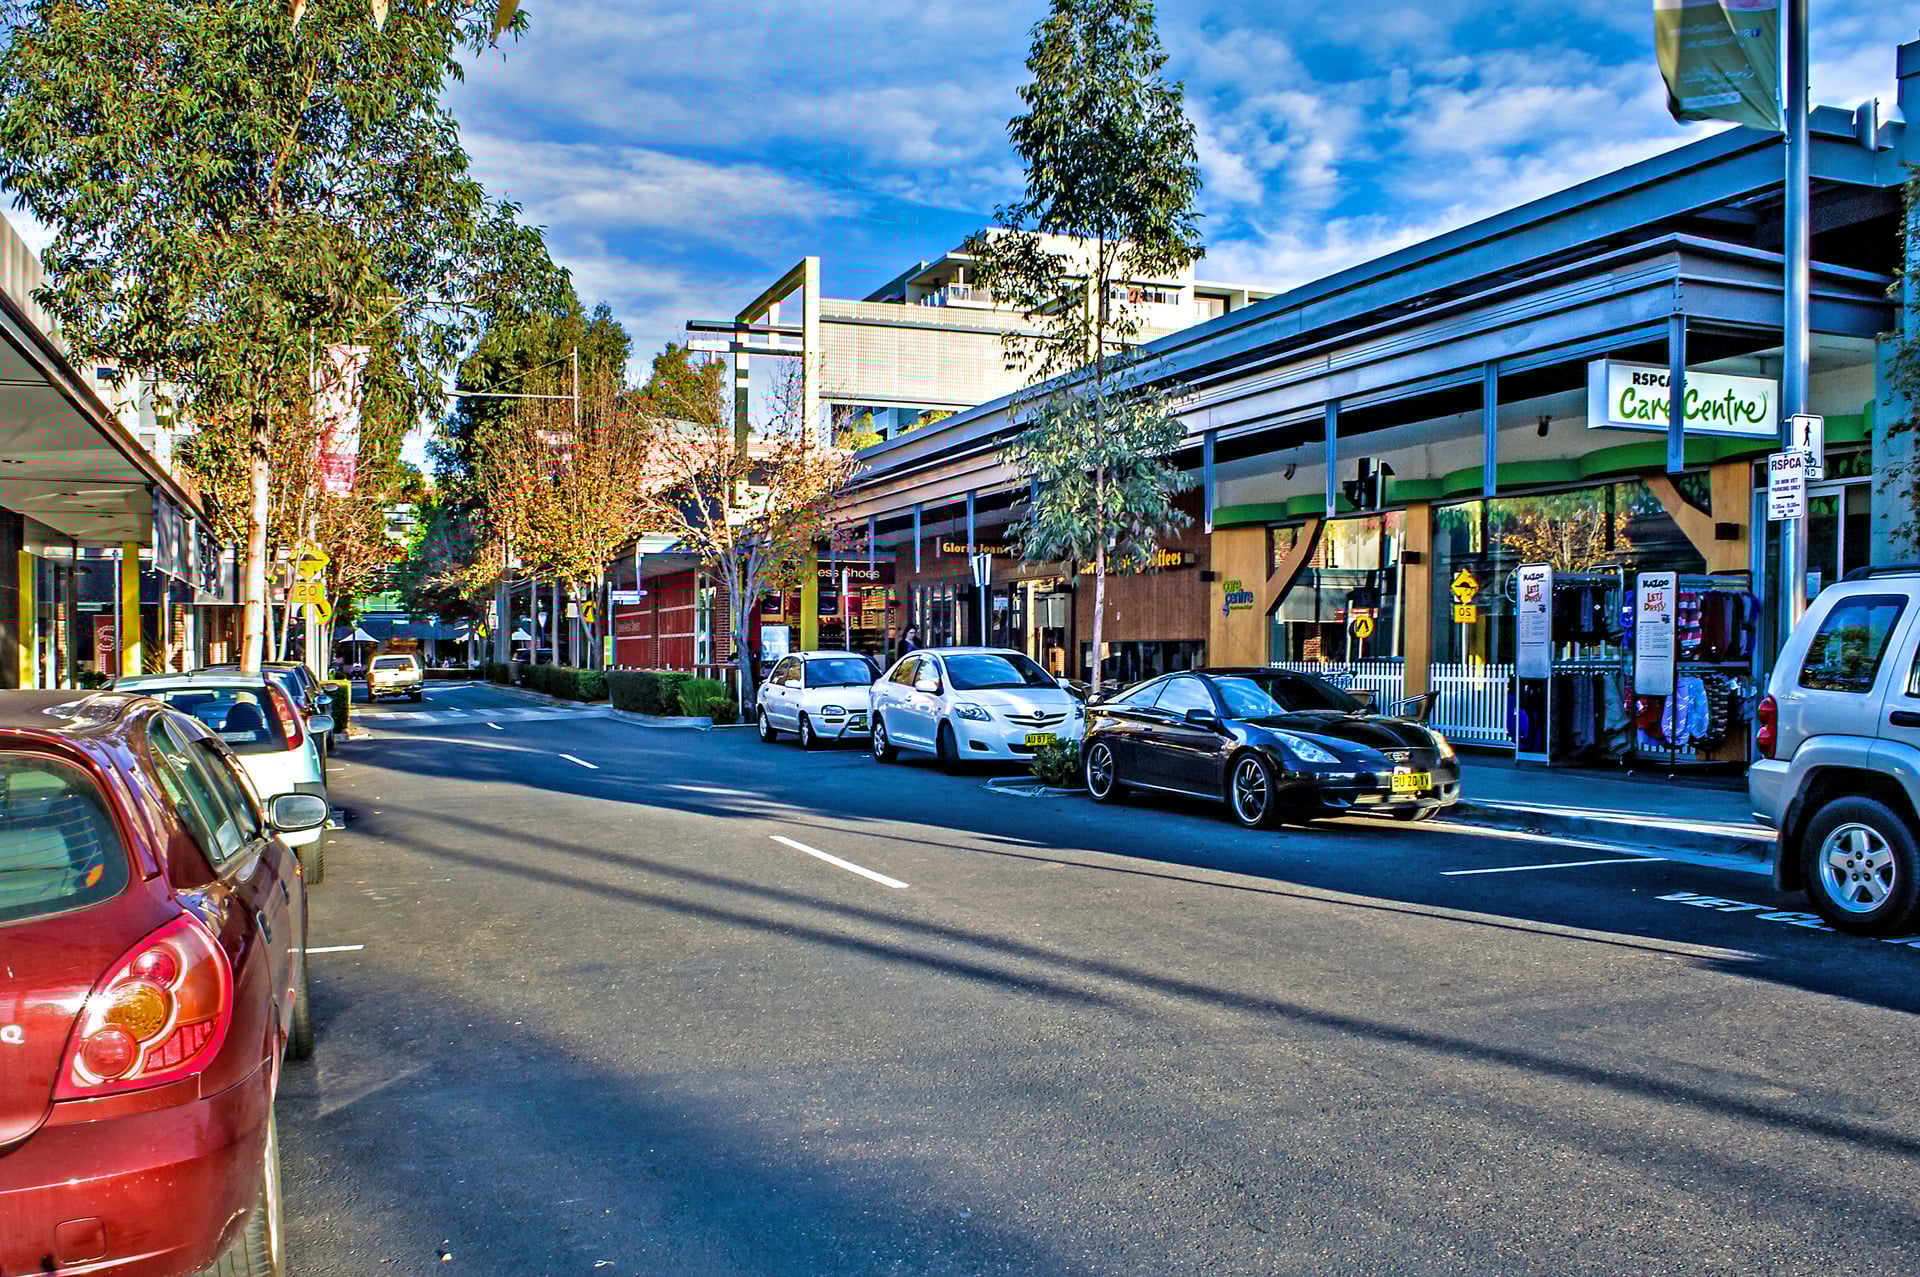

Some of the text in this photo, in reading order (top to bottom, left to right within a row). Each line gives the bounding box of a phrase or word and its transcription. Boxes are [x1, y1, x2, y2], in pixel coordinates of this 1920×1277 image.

[1684, 388, 1769, 426] Centre
[1772, 458, 1801, 470] RSPCA
[298, 585, 317, 596] 20
